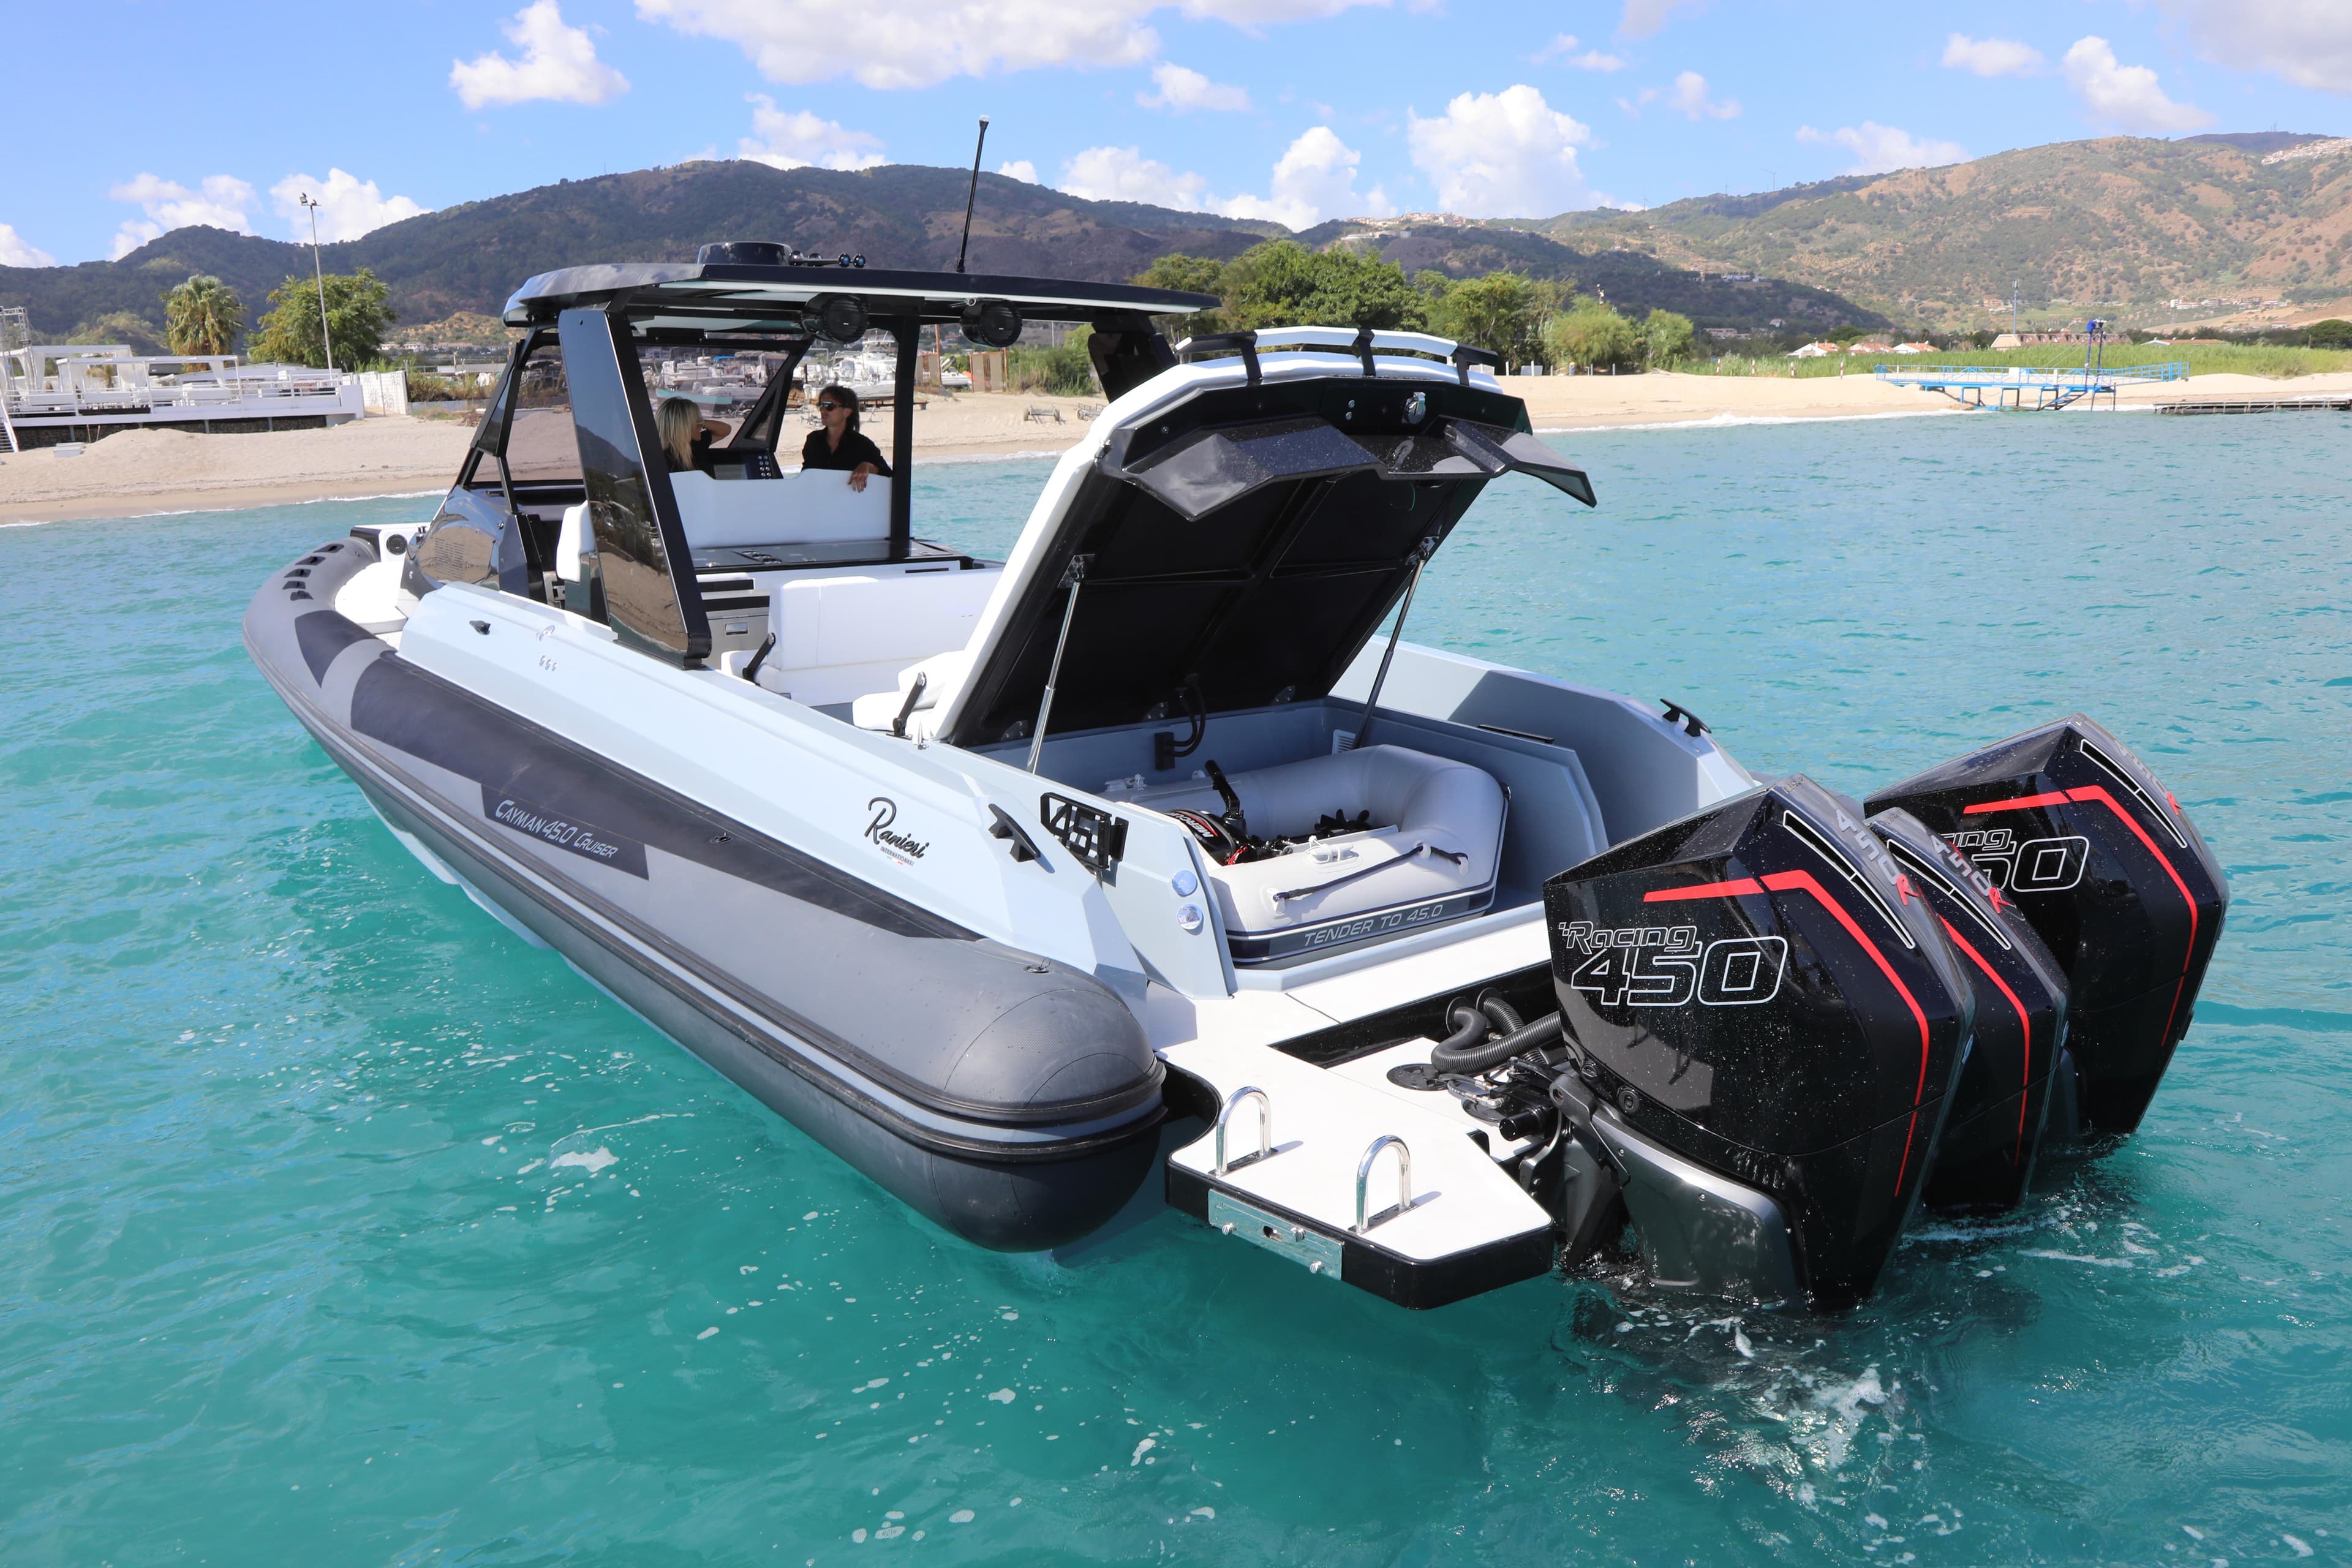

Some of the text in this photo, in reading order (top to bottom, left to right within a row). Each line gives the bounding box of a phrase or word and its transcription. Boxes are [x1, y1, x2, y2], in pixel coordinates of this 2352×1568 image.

[495, 799, 548, 834] CAYMAN
[573, 832, 619, 858] CRUISER
[864, 796, 930, 858] Ranieri
[1167, 812, 1214, 838] MERCU
[1970, 835, 2089, 892] 50
[1304, 904, 1444, 946] TENDER TO 45.0
[1559, 921, 1697, 955] Racing
[1571, 935, 1789, 1006] 450
